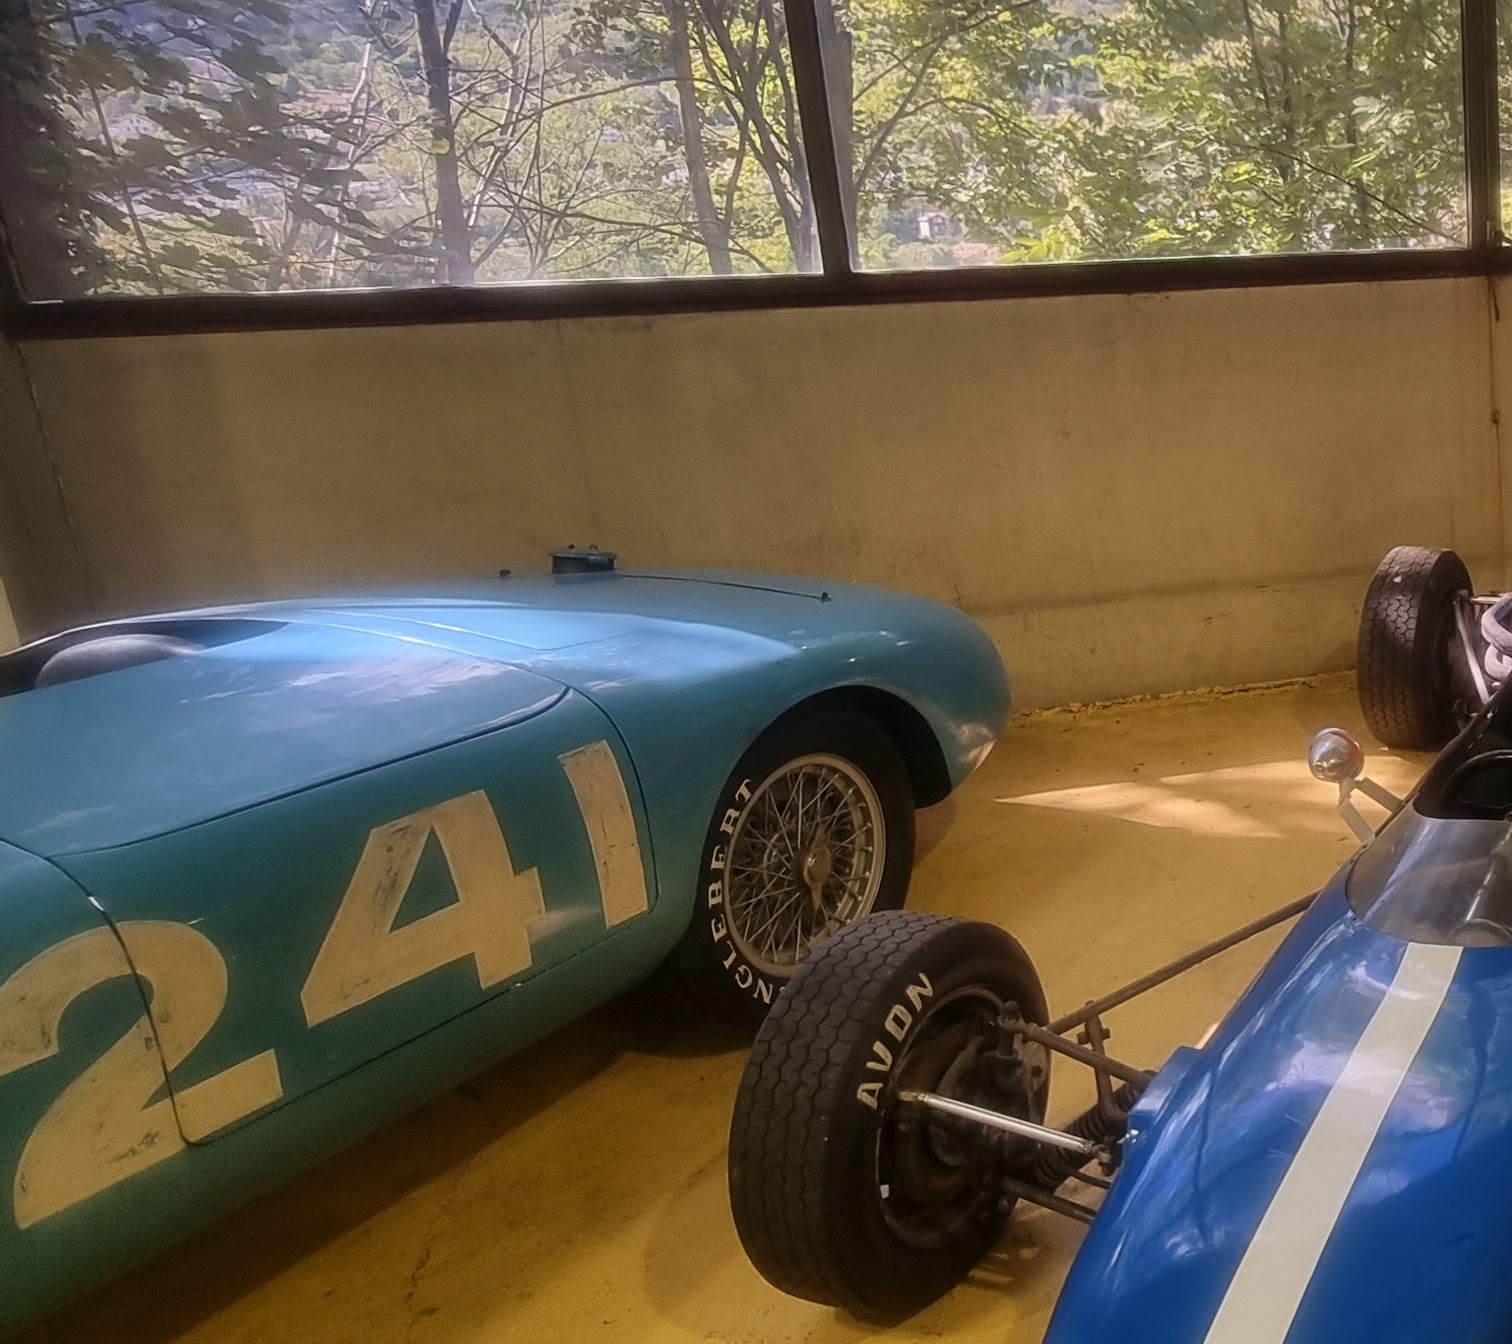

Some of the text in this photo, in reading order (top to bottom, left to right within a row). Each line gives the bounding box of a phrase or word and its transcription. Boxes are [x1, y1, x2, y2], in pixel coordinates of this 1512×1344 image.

[0, 739, 647, 1230] 241
[708, 778, 786, 1005] NGLEBERT
[857, 972, 934, 1110] AVON
